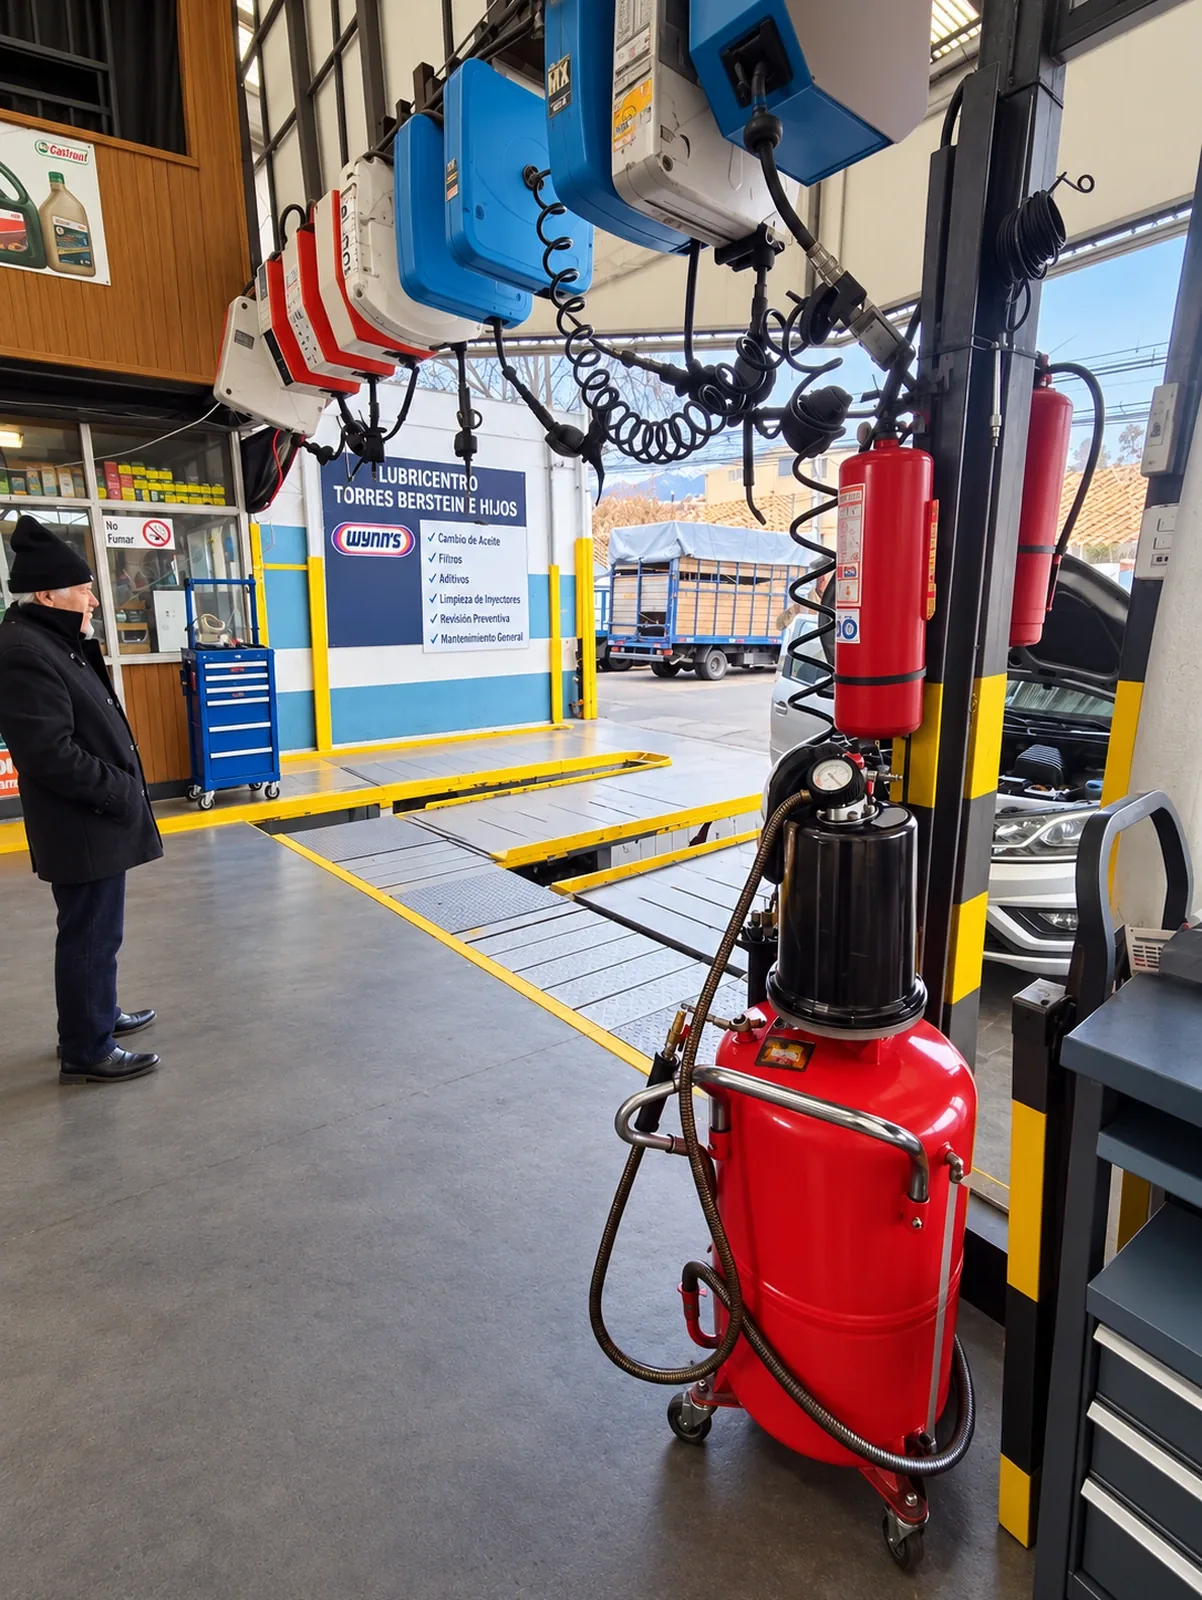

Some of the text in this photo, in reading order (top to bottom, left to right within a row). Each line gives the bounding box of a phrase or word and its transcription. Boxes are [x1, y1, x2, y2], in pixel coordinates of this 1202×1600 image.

[378, 465, 478, 491] LUBRICENTRO
[333, 485, 517, 517] TORRES BERSTEIN E HIJOS
[106, 520, 118, 530] No
[107, 533, 134, 544] Fumar
[438, 532, 500, 546] Cambio de Aceite
[438, 553, 462, 564] Filtros
[439, 573, 469, 584] Aditivos
[440, 594, 521, 606] Limpieza de Inyectores
[440, 613, 510, 624] Revisión Preventiva
[440, 632, 523, 644] Mantenimiento General
